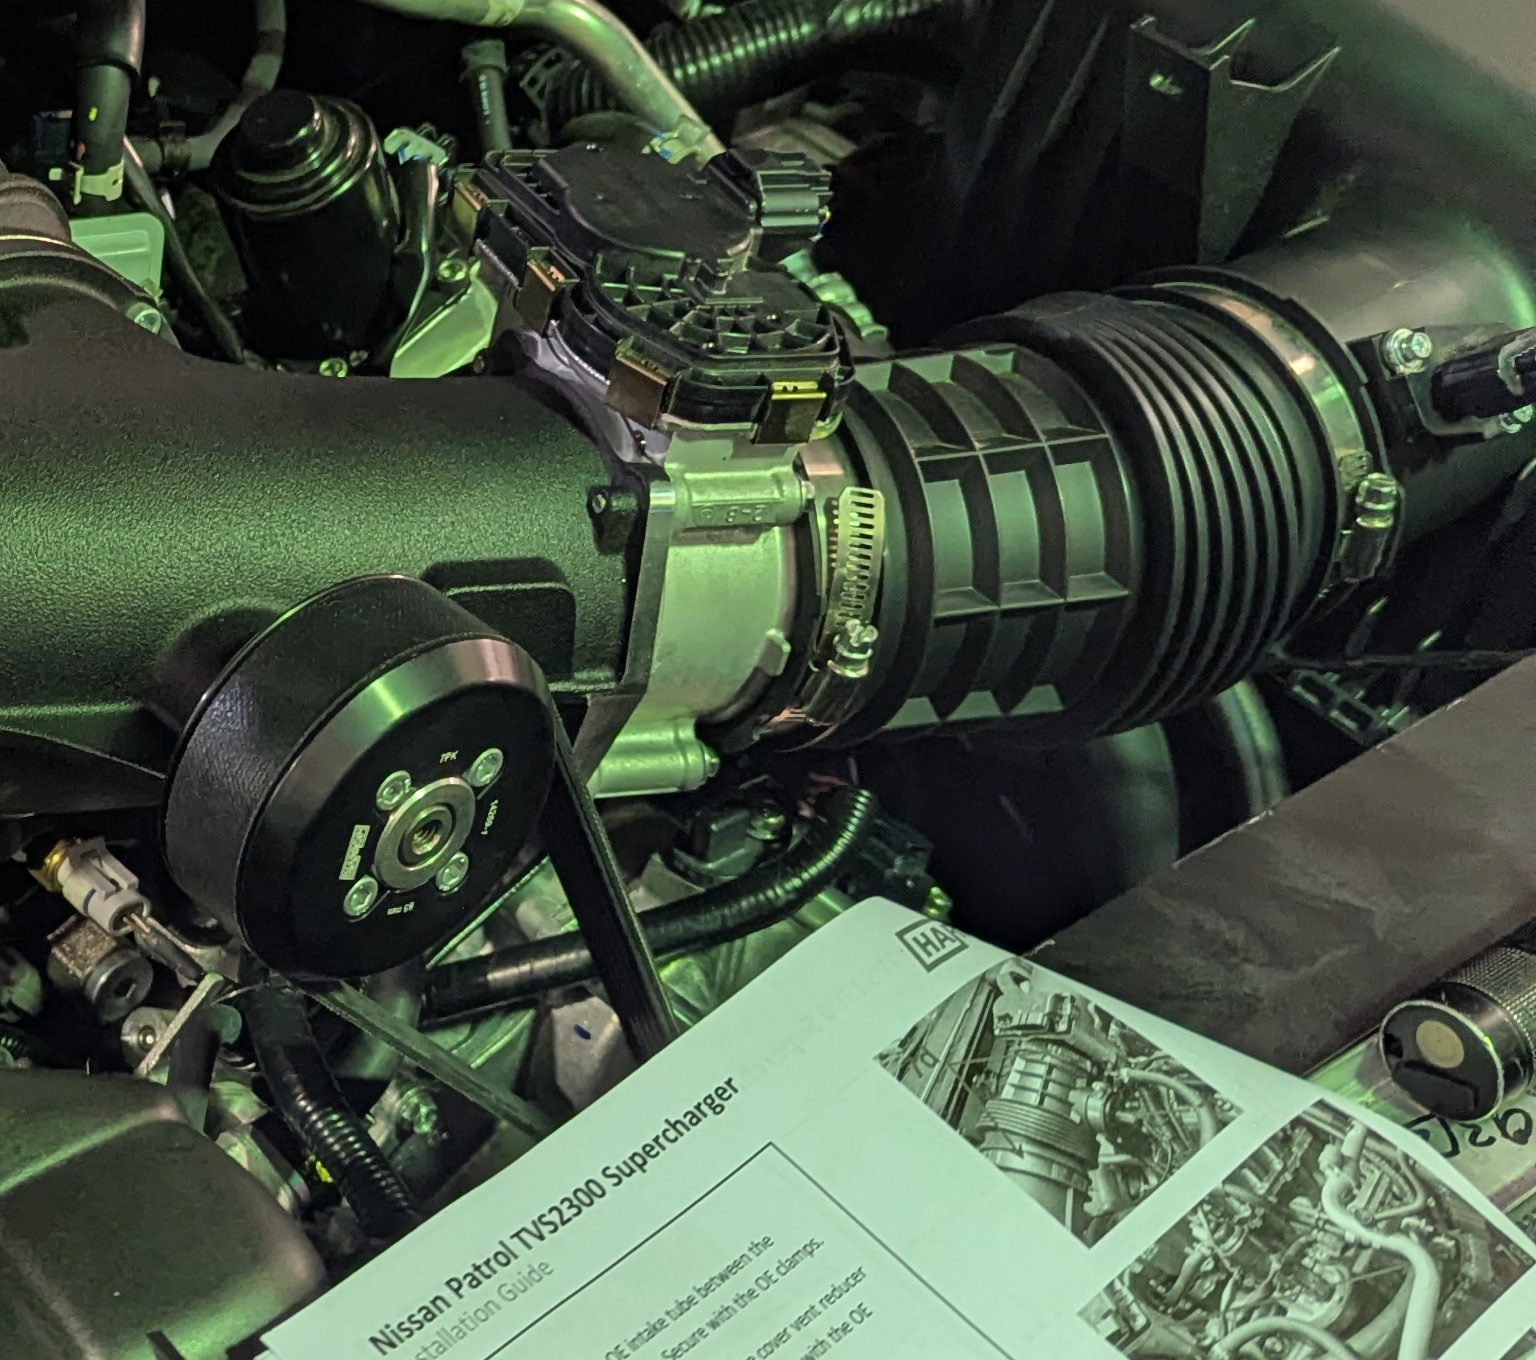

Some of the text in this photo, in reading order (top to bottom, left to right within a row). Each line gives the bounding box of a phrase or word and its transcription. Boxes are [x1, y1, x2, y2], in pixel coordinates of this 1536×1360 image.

[368, 1076, 739, 1356] Nissan Patrol TVS2300 Supercharger
[496, 1261, 555, 1303] Guide
[623, 1317, 670, 1352] intake
[664, 1294, 700, 1322] tube
[692, 1253, 753, 1299] between
[747, 1236, 775, 1257] the
[704, 1304, 738, 1331] with
[732, 1287, 760, 1309] the
[754, 1269, 780, 1291] OE
[775, 1237, 825, 1277] clamps.
[756, 1326, 792, 1360] cover
[789, 1303, 823, 1332] vent
[818, 1266, 867, 1310] reducer
[826, 1321, 854, 1344] the
[848, 1301, 874, 1325] OE
